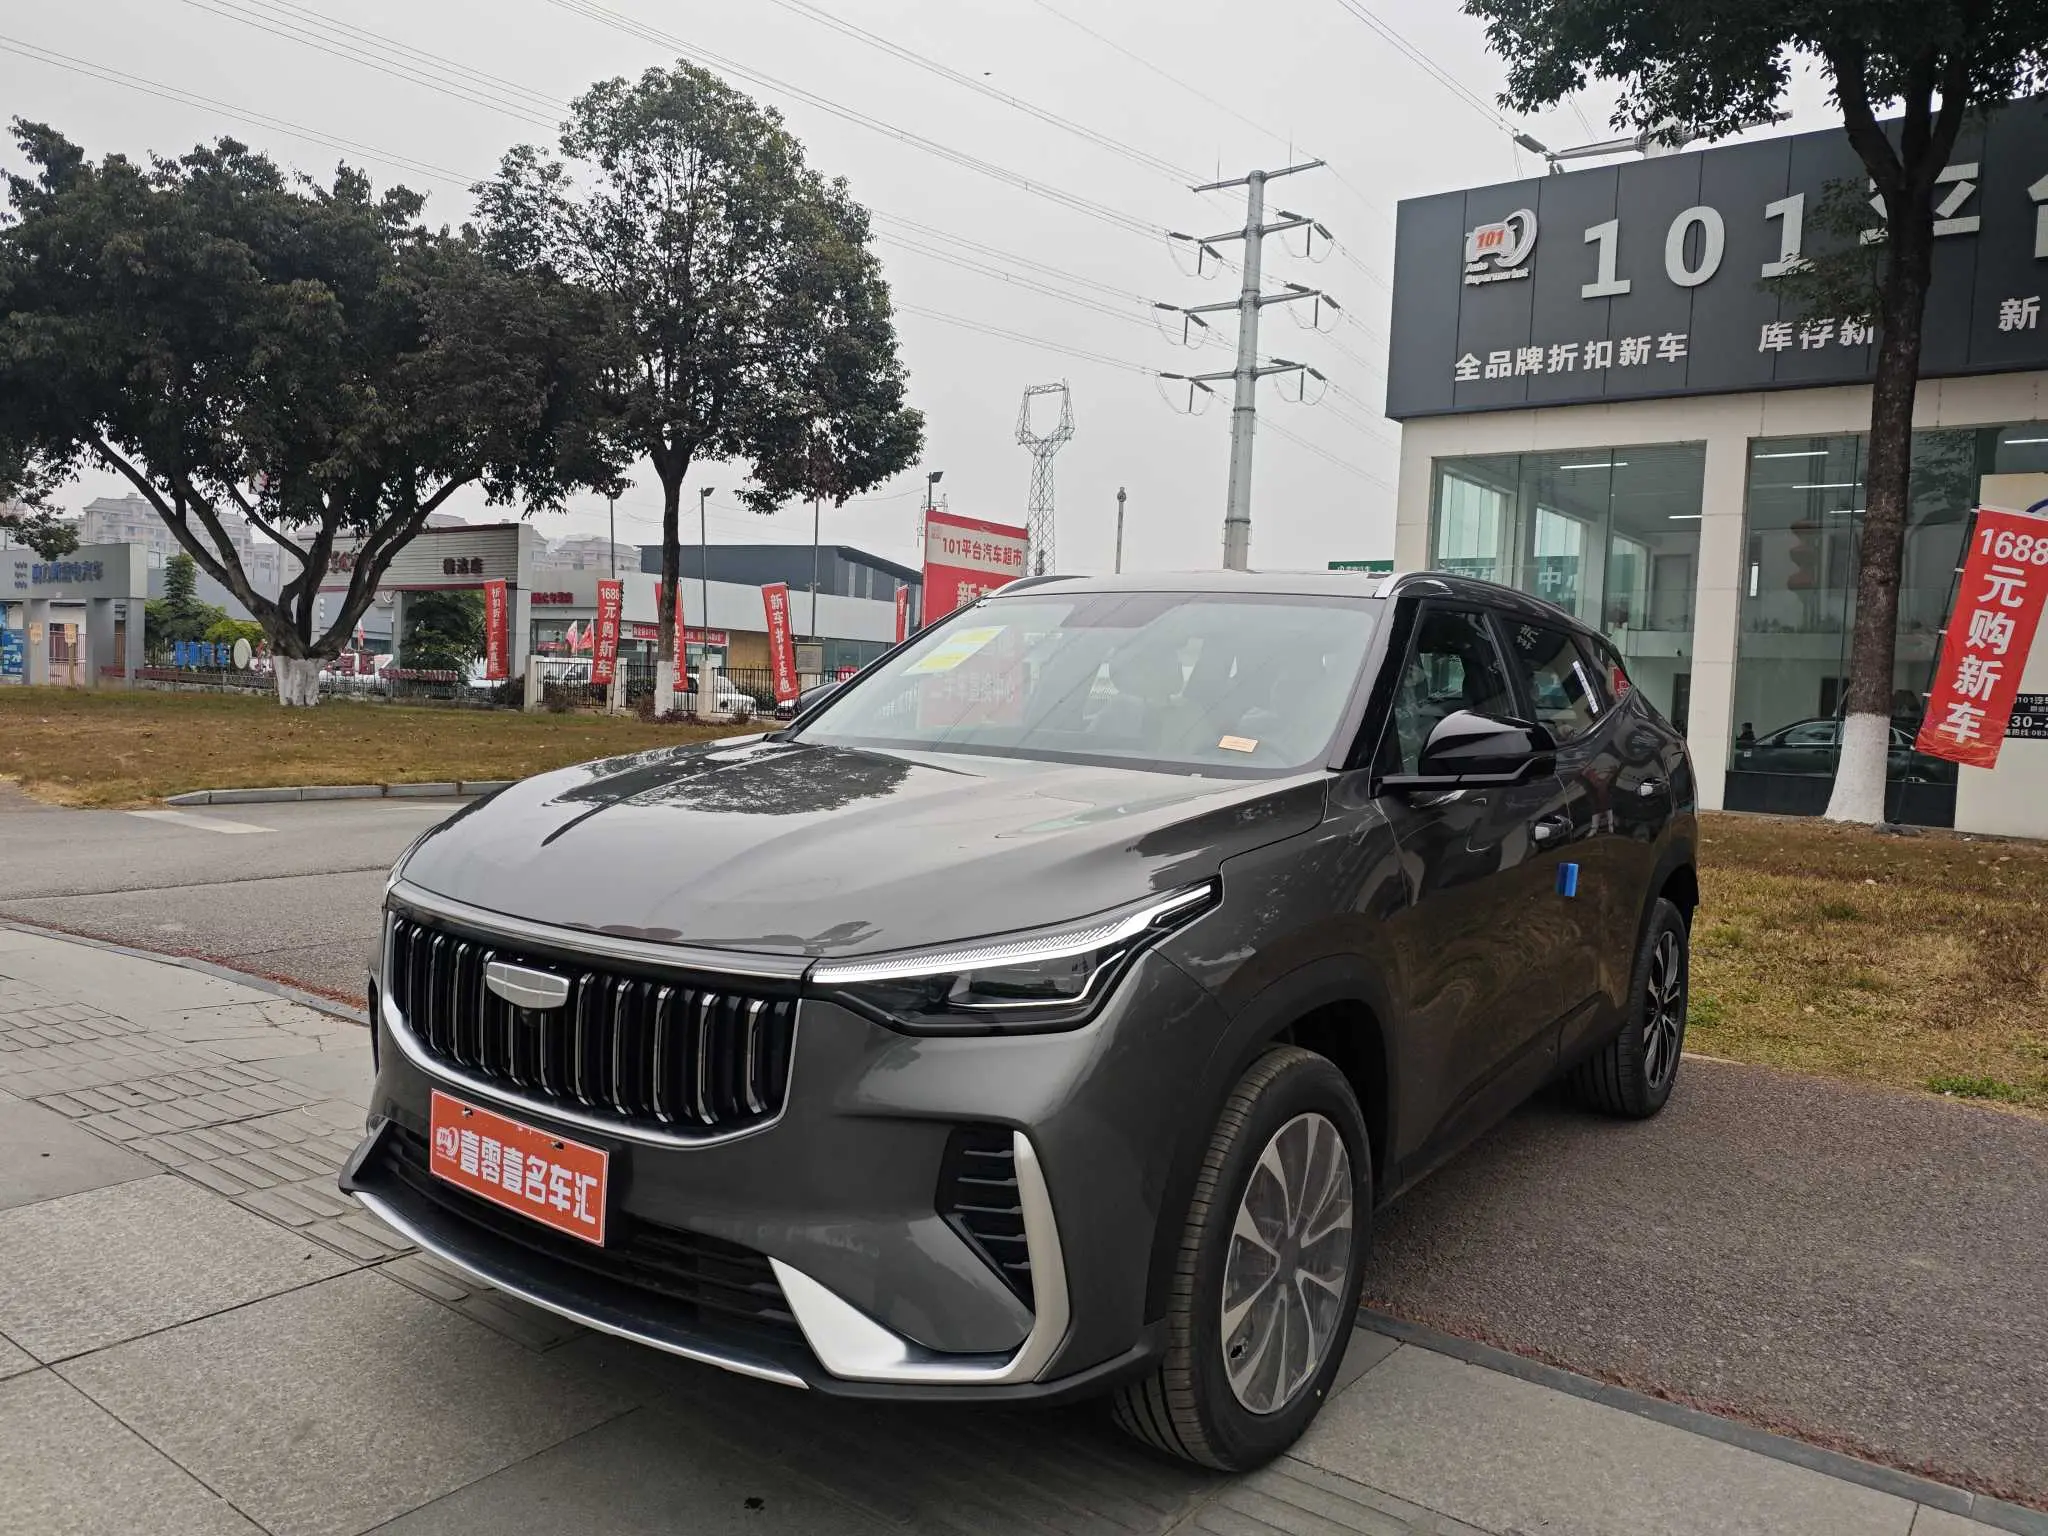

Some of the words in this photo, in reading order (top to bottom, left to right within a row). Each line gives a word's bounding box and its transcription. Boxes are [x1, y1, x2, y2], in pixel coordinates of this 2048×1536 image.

[1454, 332, 1688, 382] 全品牌折扣新车
[1758, 313, 1875, 353] 库存新
[942, 537, 1023, 567] 101平台汽车超市
